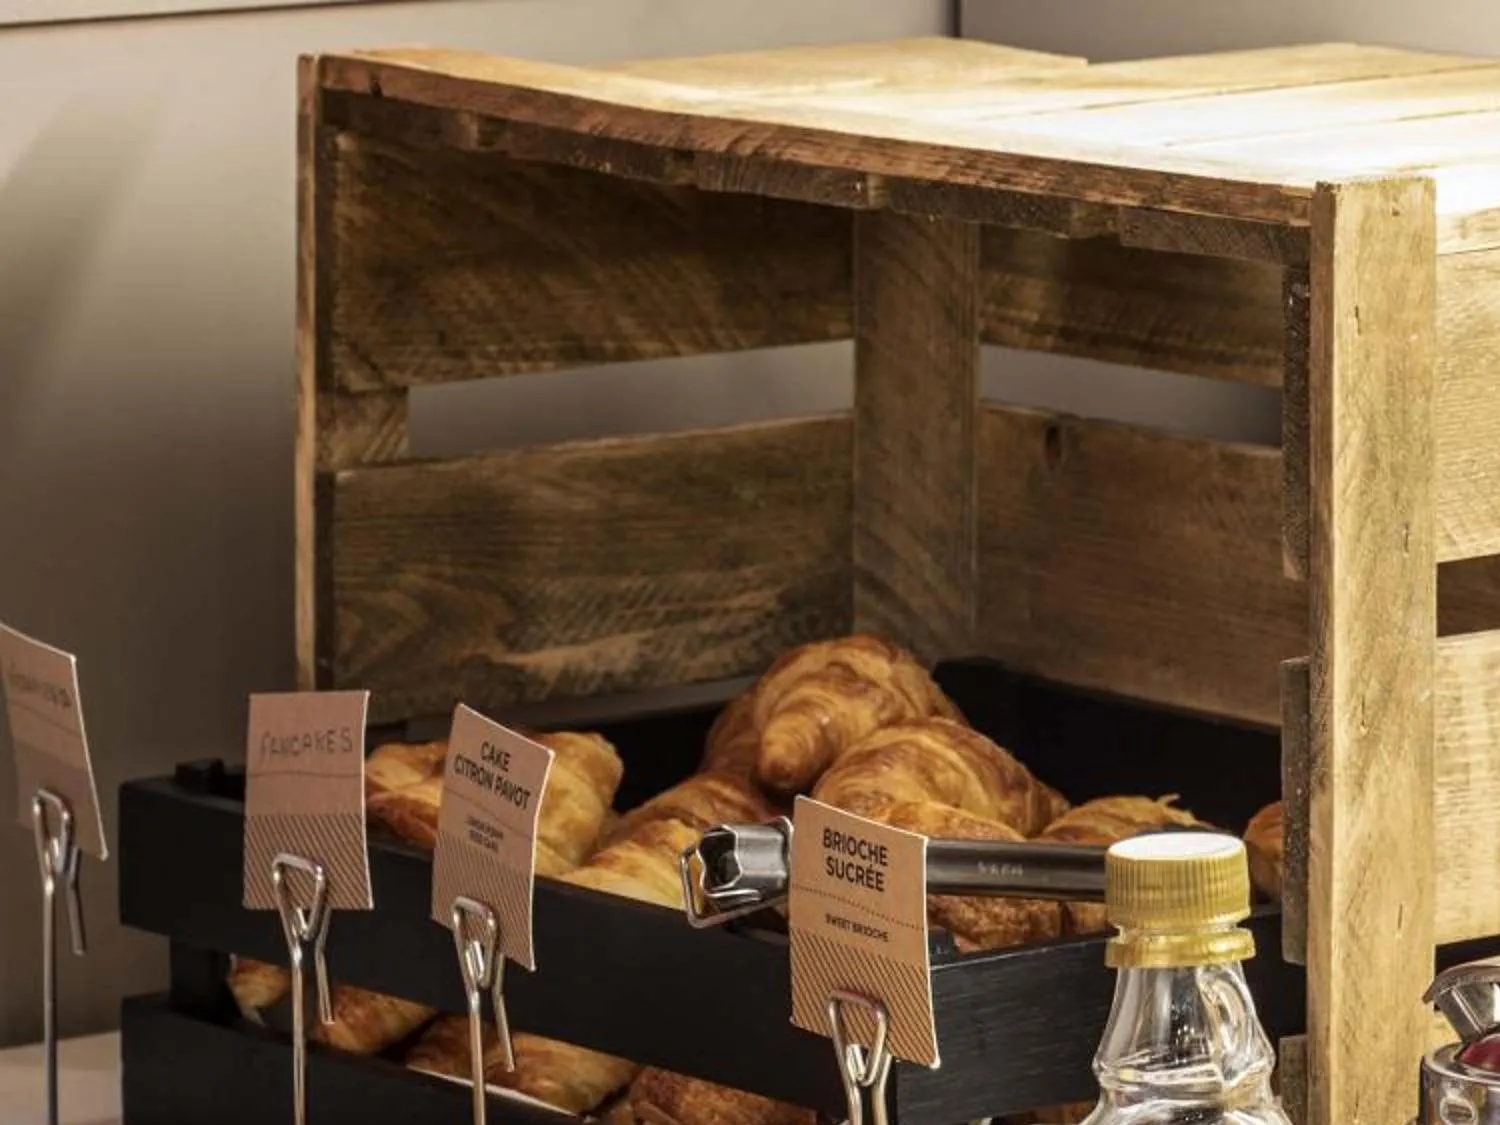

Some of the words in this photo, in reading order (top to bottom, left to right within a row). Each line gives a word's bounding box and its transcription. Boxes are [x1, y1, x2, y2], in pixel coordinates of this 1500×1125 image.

[480, 742, 511, 772] CAKE
[454, 755, 492, 790] CITRON
[494, 774, 532, 810] PAVOT
[823, 828, 888, 867] BRIOCHE
[826, 855, 885, 892] SUCRÉE
[825, 913, 852, 932] SWEET
[852, 921, 889, 943] BRIOCHE
